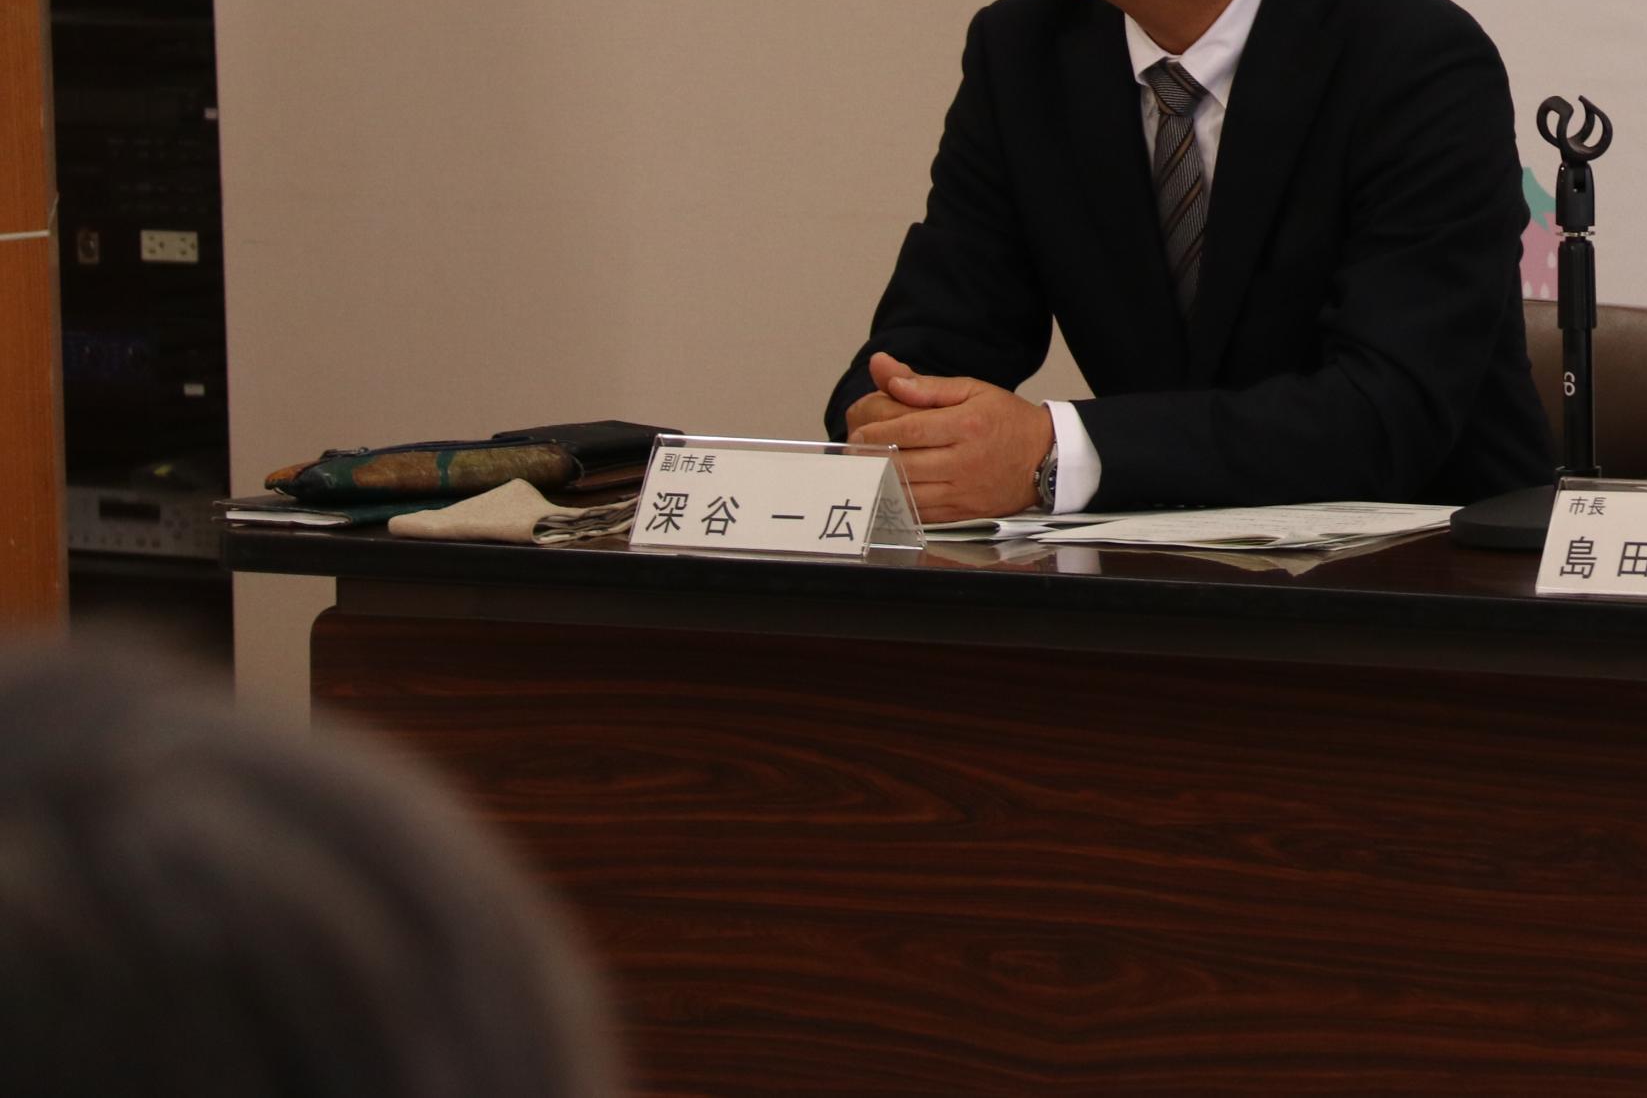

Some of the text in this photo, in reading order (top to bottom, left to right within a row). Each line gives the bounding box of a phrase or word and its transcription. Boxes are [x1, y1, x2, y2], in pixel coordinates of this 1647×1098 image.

[660, 453, 716, 475] 副市長
[1570, 497, 1606, 515] 市長
